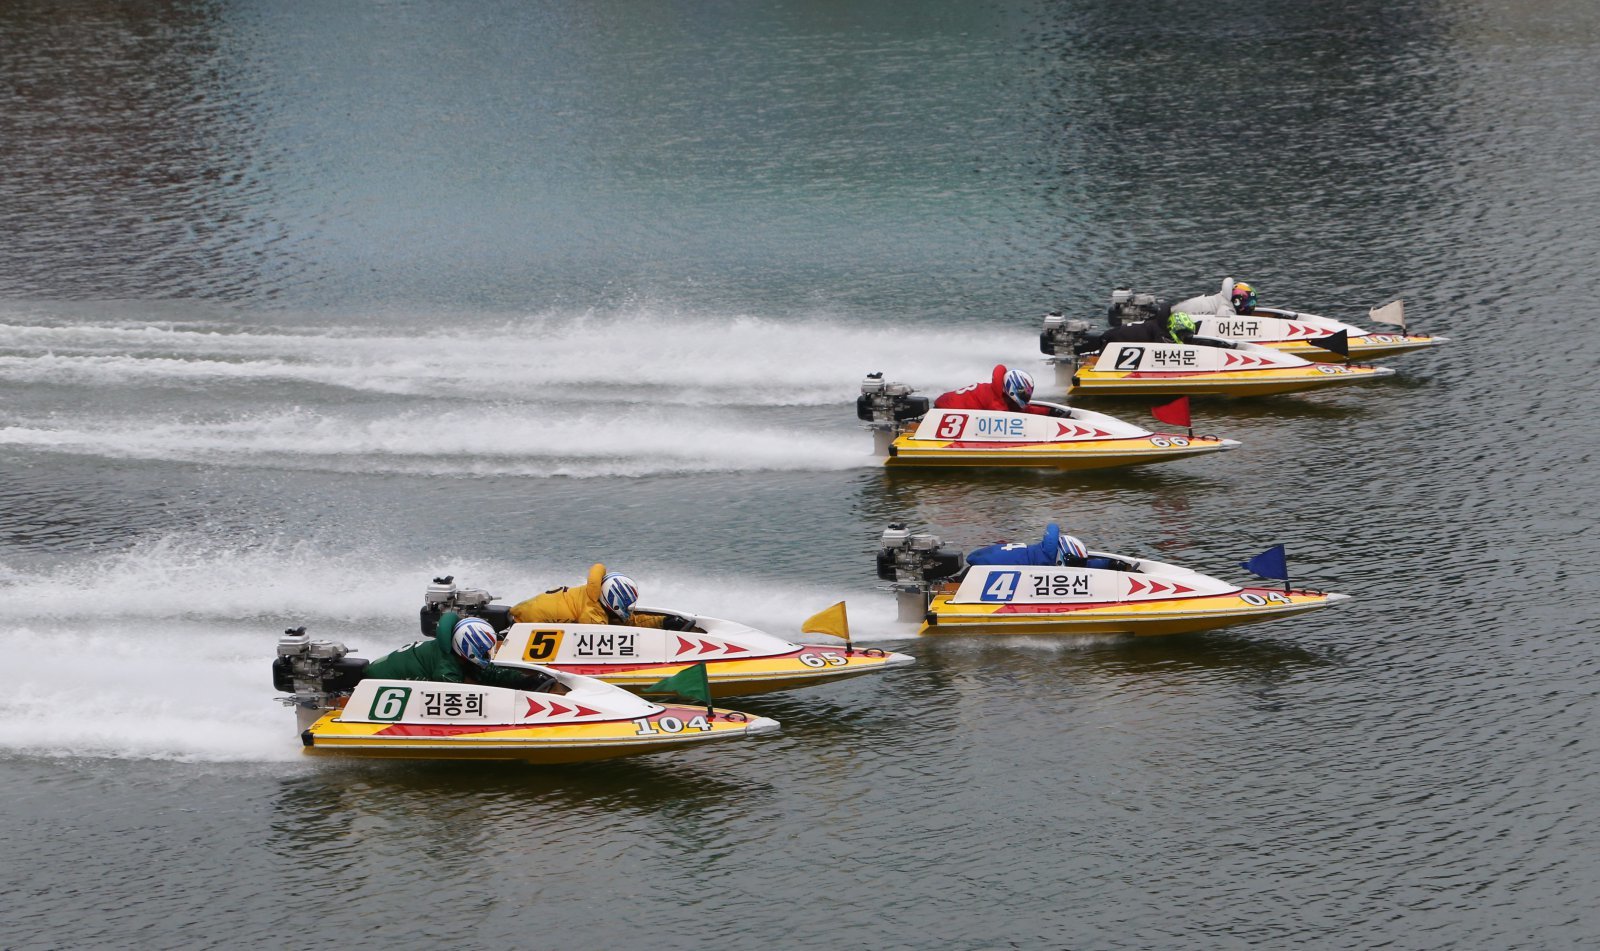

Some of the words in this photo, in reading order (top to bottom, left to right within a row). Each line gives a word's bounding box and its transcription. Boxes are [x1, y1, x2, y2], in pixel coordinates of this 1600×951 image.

[1218, 321, 1259, 336] 어선규
[1117, 348, 1141, 369] 2
[1154, 350, 1196, 366] 박석문
[940, 415, 964, 438] 3
[978, 417, 1024, 435] 이지은
[1150, 436, 1190, 448] 66
[986, 573, 1015, 600] 4
[1034, 575, 1088, 596] 김응선
[1240, 592, 1292, 606] 04
[529, 631, 558, 660] 5
[577, 634, 634, 656] 신선길
[799, 651, 849, 668] 65
[374, 688, 406, 719] 6
[425, 692, 483, 717] 김종희
[632, 715, 713, 735] 104
